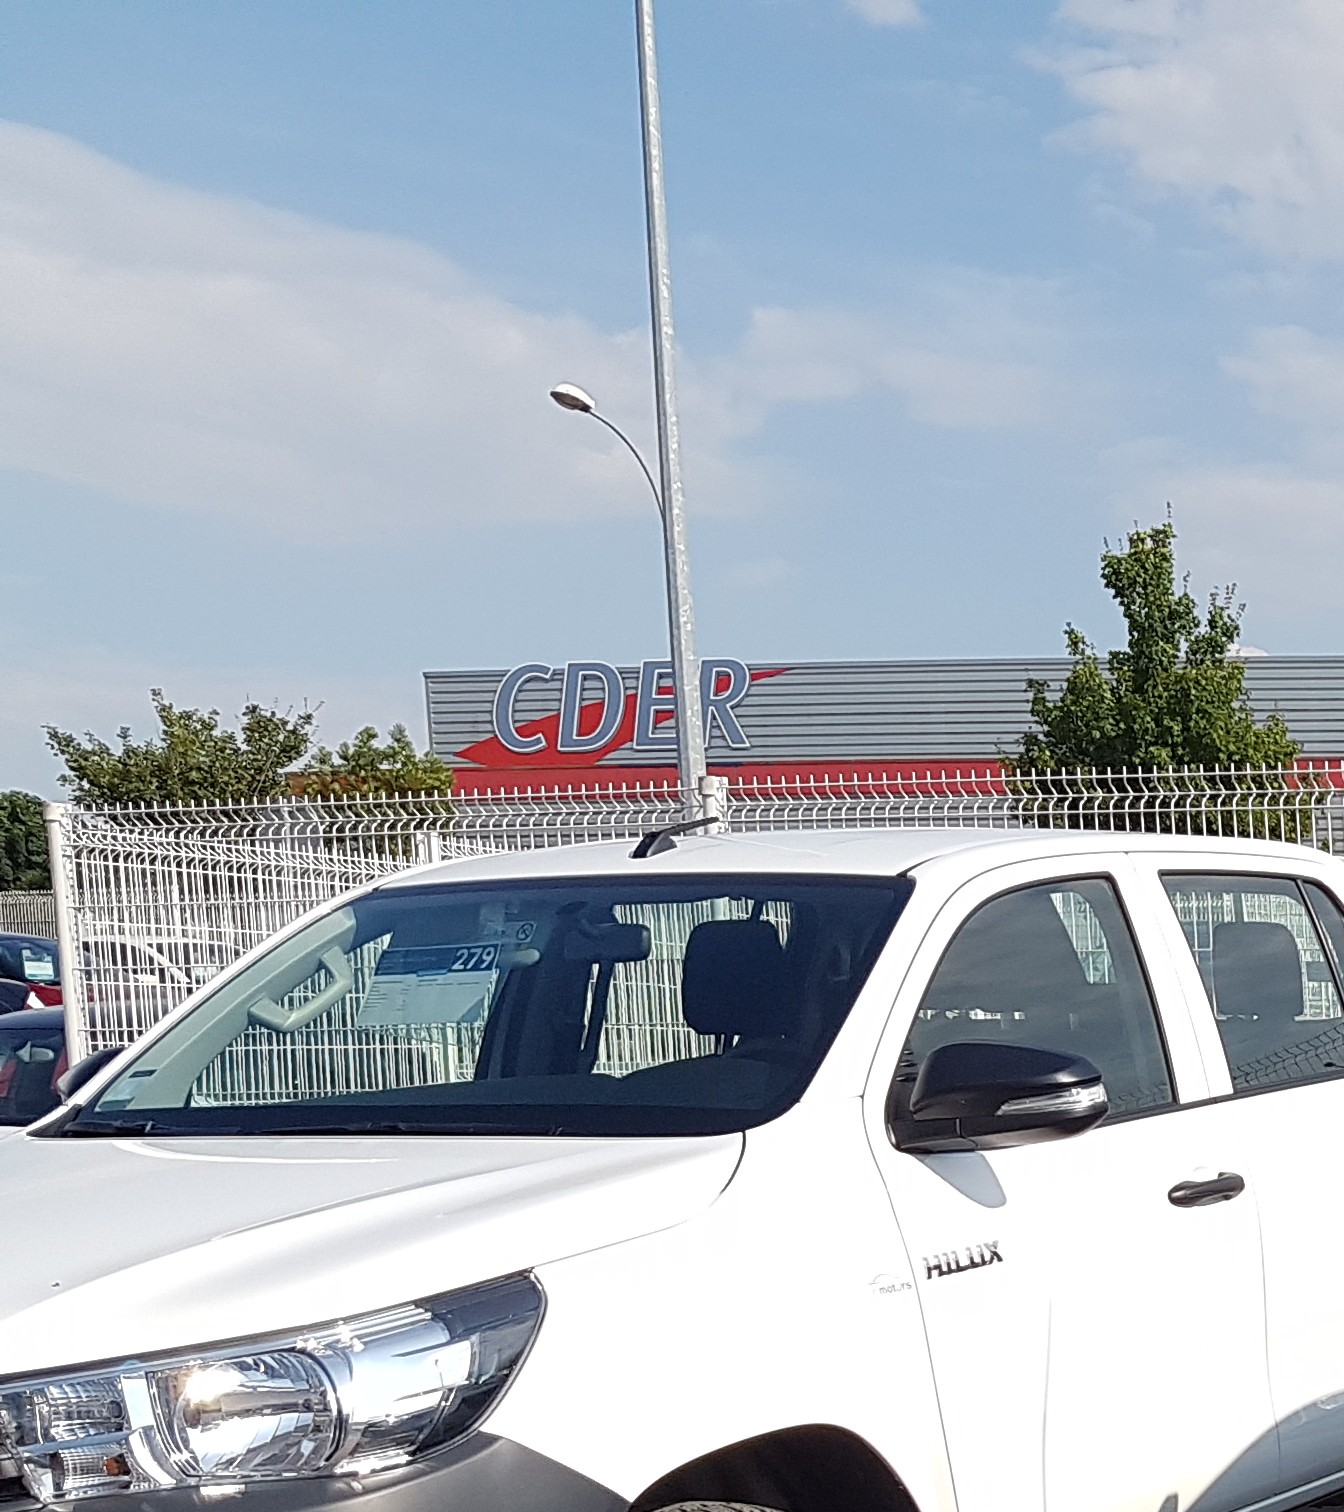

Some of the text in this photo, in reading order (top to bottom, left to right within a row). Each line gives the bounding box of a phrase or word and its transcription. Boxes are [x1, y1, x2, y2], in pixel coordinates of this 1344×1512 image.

[493, 656, 750, 753] CDER
[451, 948, 495, 970] 279
[922, 1240, 1004, 1280] HILUX
